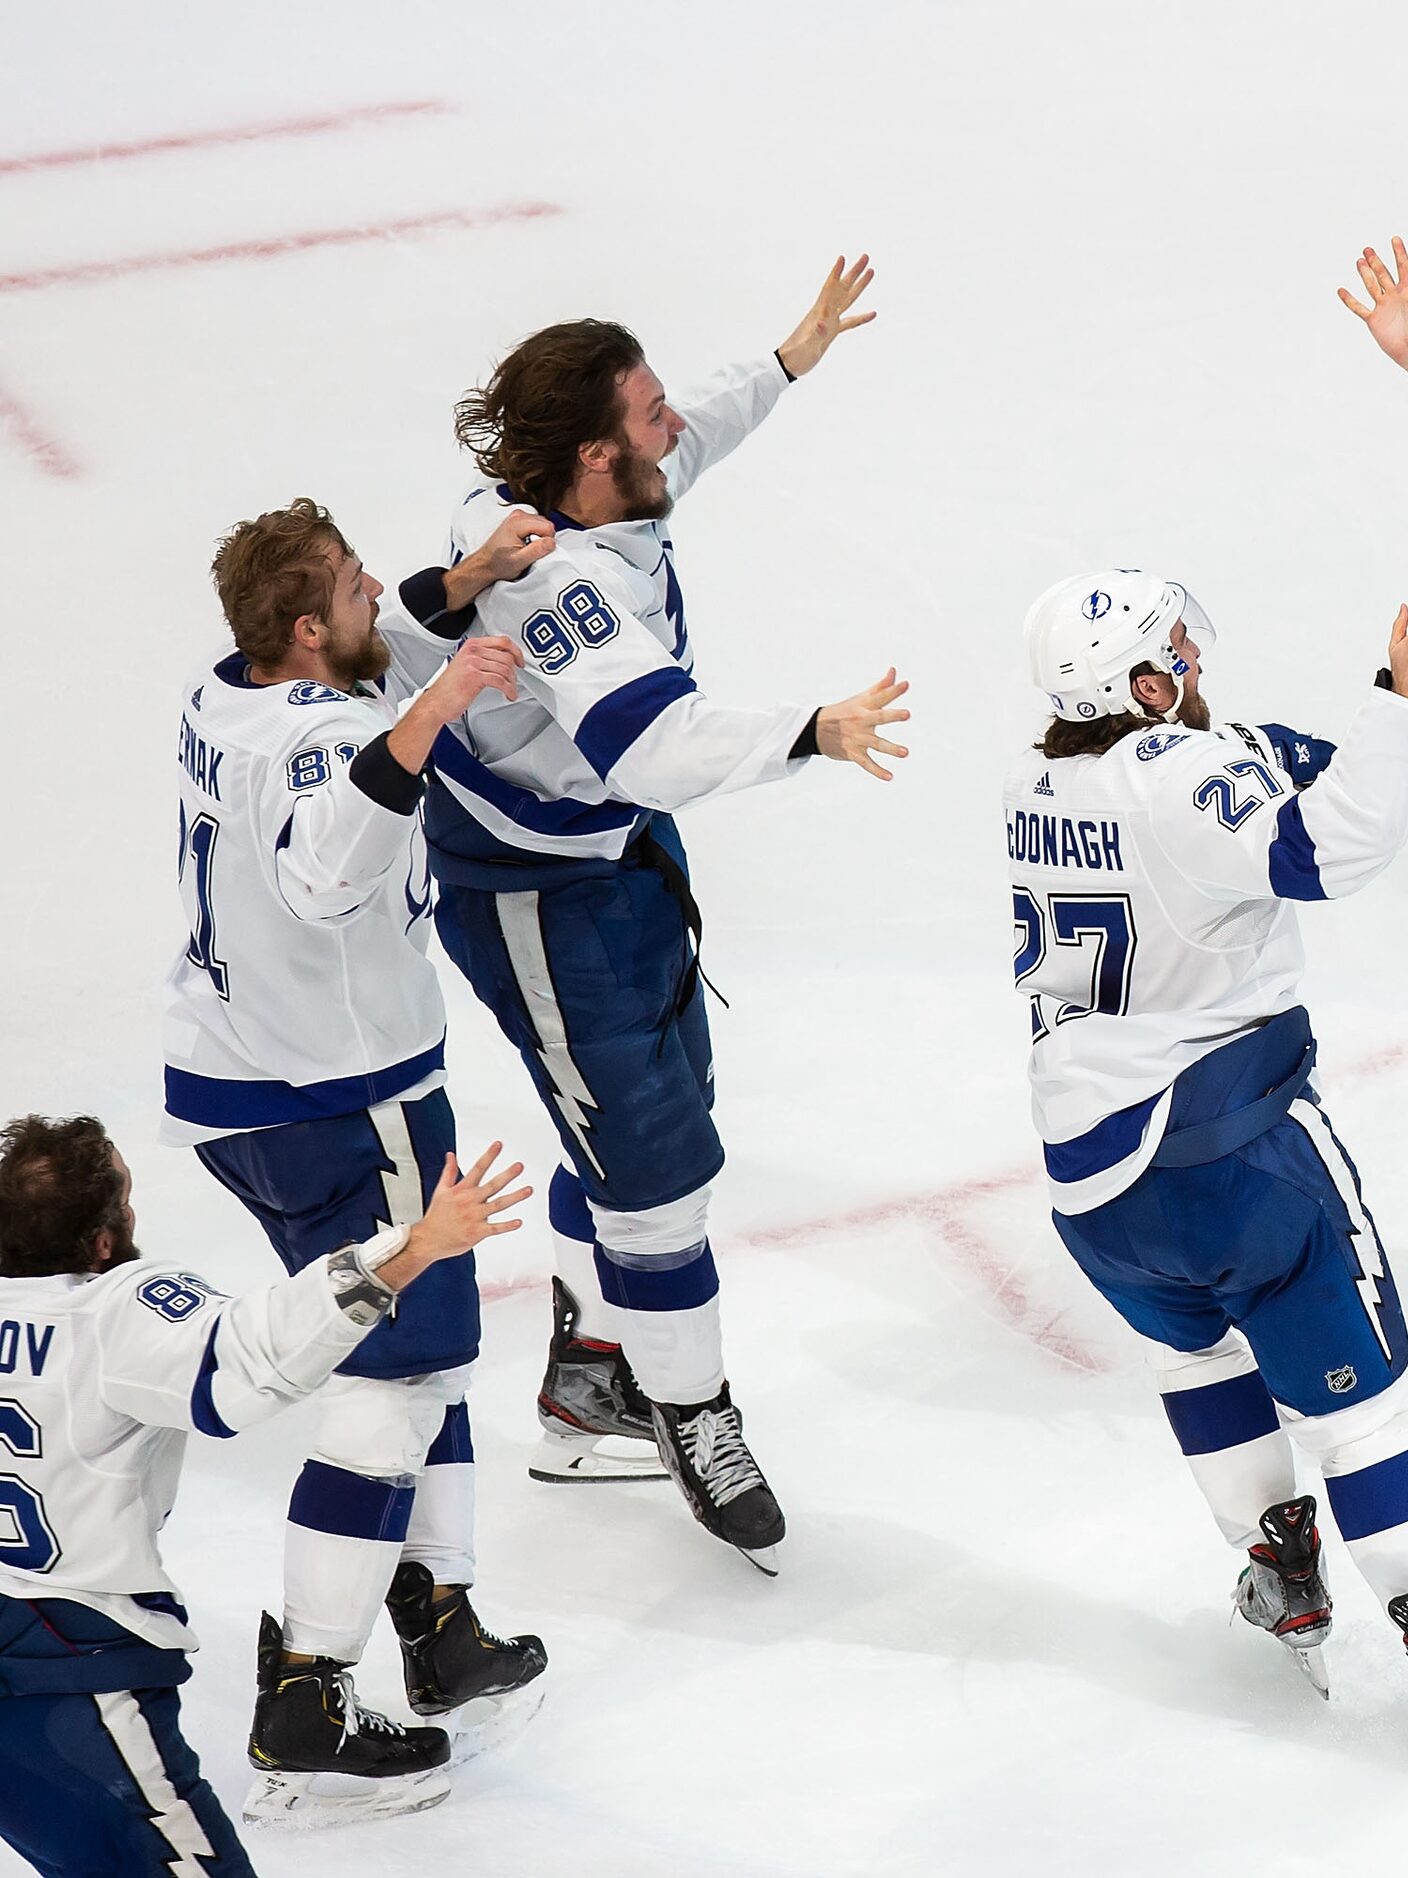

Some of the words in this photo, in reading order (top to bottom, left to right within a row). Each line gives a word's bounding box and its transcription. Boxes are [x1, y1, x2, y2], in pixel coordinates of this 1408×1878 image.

[521, 579, 621, 675] 98
[1033, 787, 1055, 797] adidas
[1193, 759, 1285, 833] 27
[1005, 808, 1124, 872] cDONAGH
[1334, 1372, 1349, 1388] NHL
